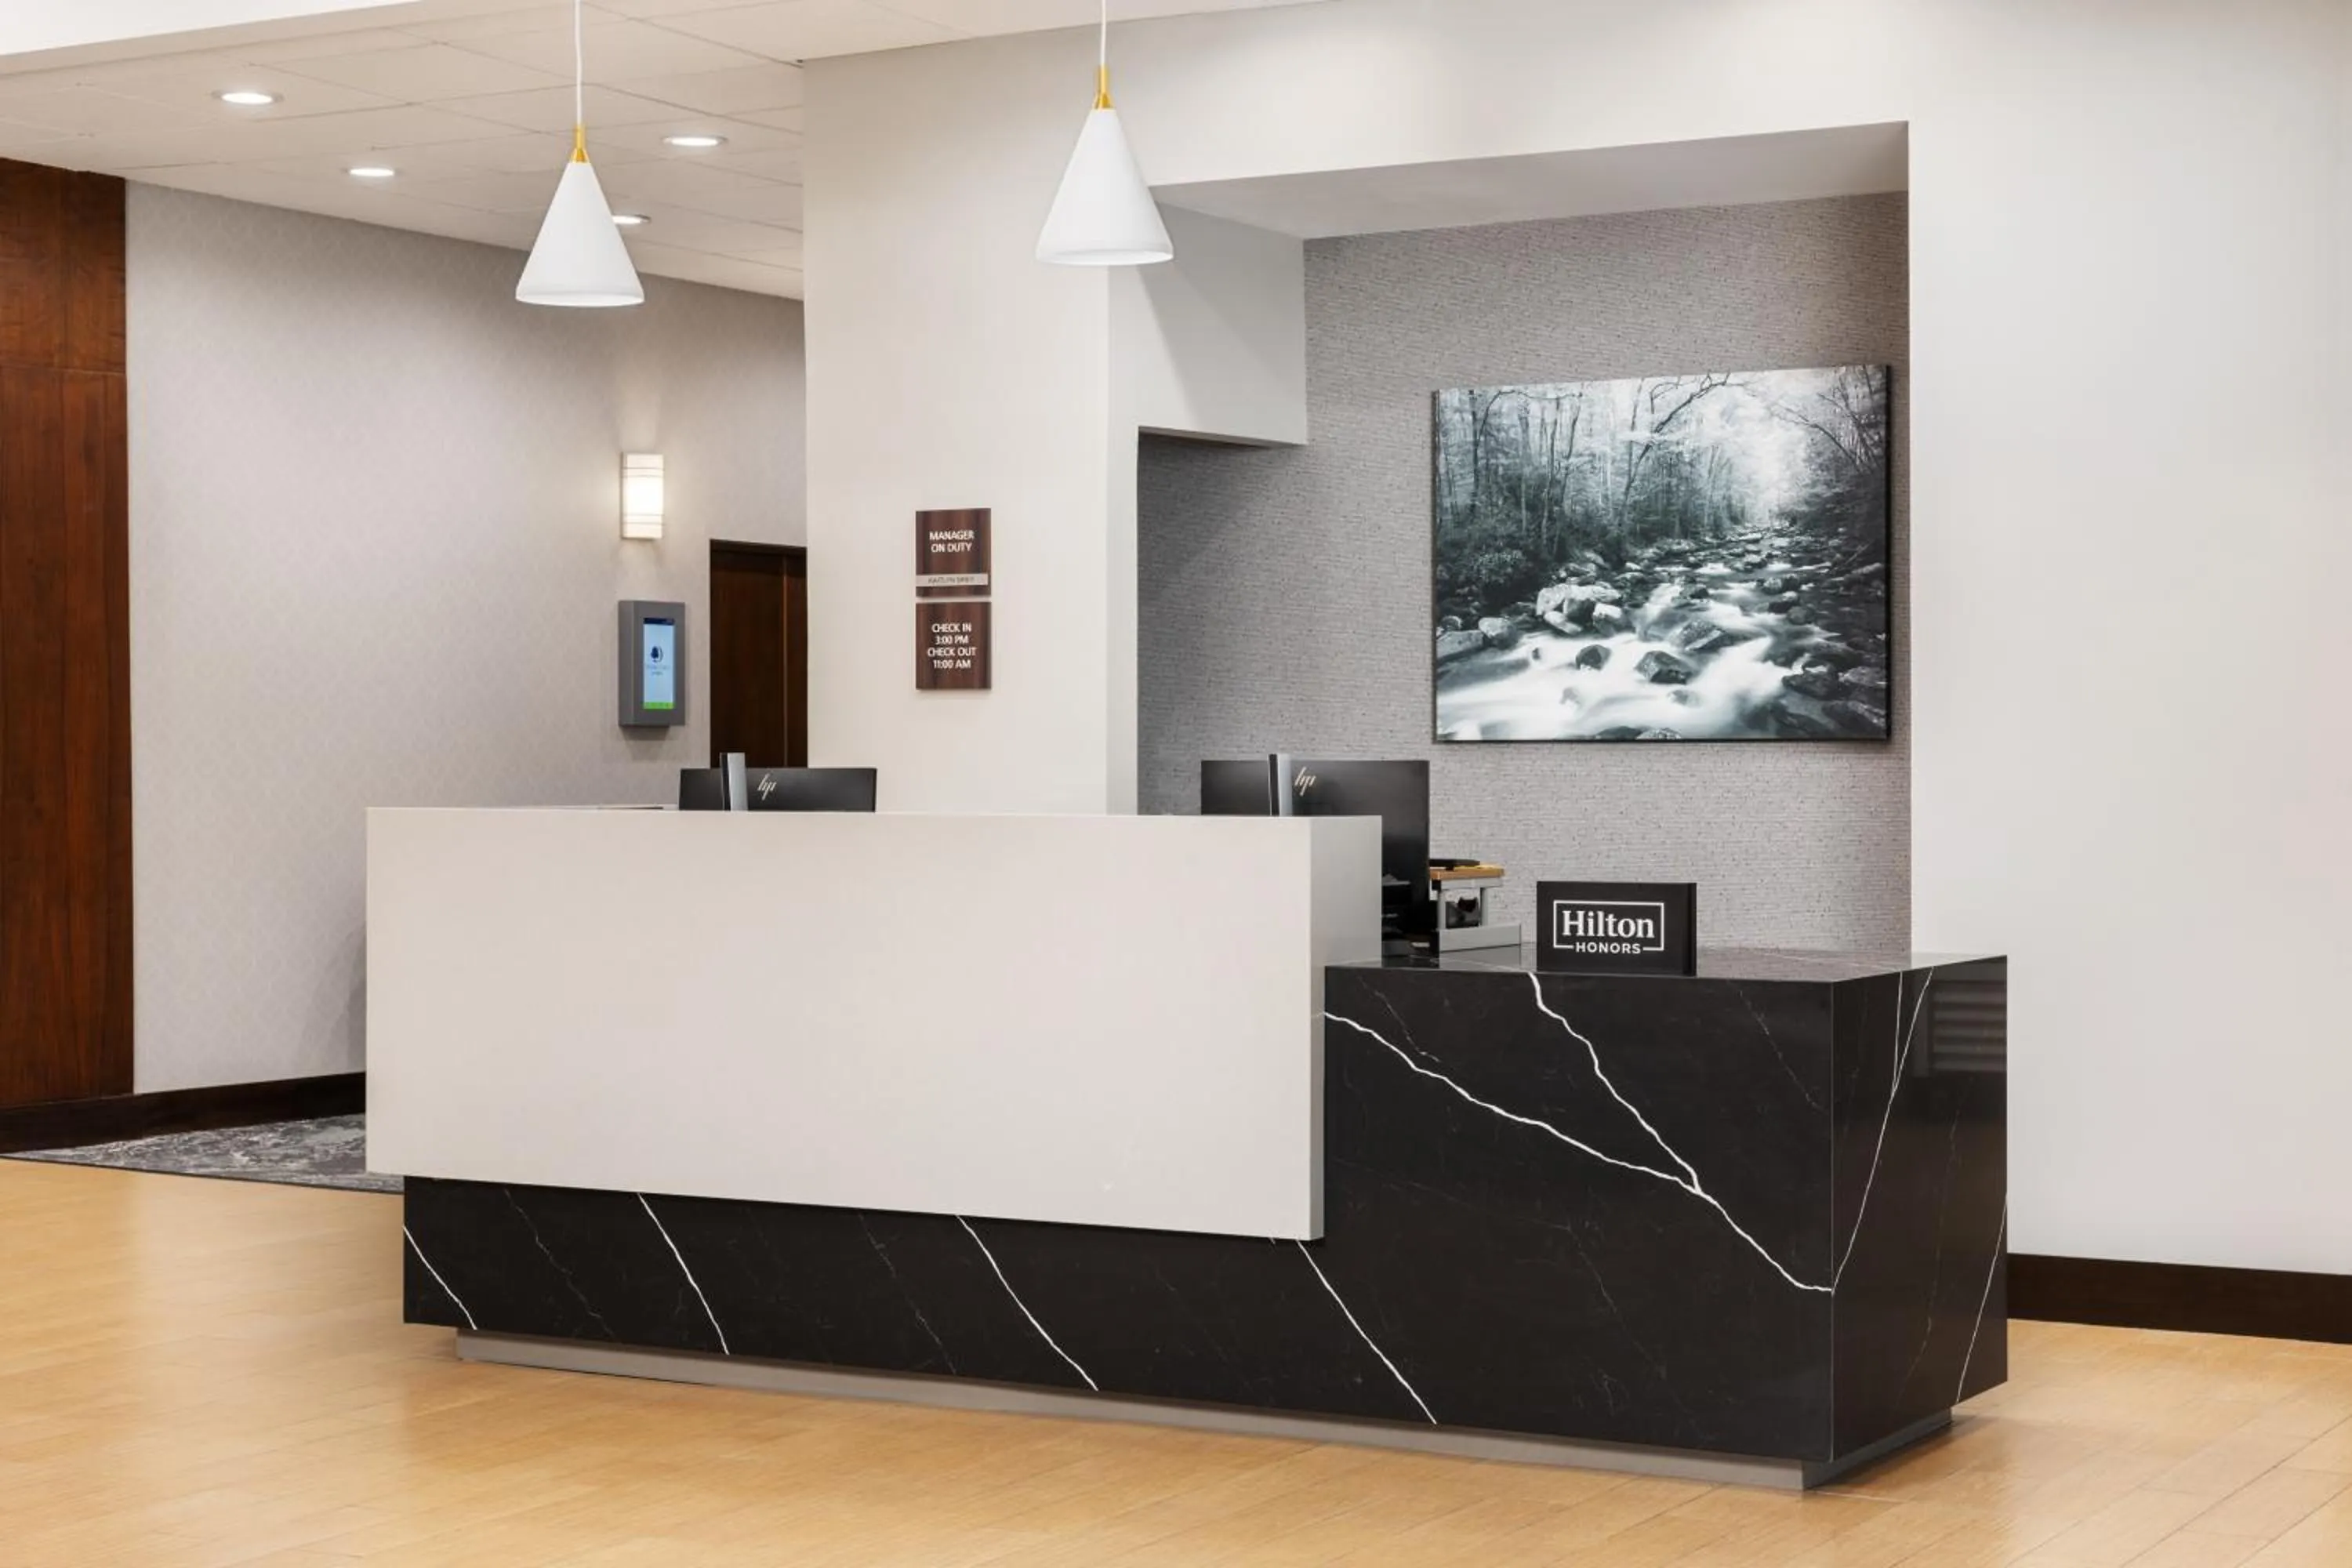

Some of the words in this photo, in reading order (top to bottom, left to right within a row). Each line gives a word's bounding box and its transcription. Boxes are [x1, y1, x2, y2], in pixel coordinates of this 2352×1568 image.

[929, 530, 975, 540] MANAGER
[931, 543, 946, 553] ON
[947, 542, 973, 552] DUTY
[931, 622, 960, 633] CHECK
[962, 622, 971, 632] IN
[935, 635, 953, 644] 3:00
[954, 635, 969, 644] PM
[927, 647, 956, 657] CHECK
[957, 647, 977, 656] OUT
[933, 659, 954, 669] 11:00
[955, 659, 971, 668] AM
[757, 773, 777, 800] hp
[1294, 766, 1316, 797] hp
[1562, 910, 1655, 938] Hilton
[1575, 942, 1641, 954] HONORS
